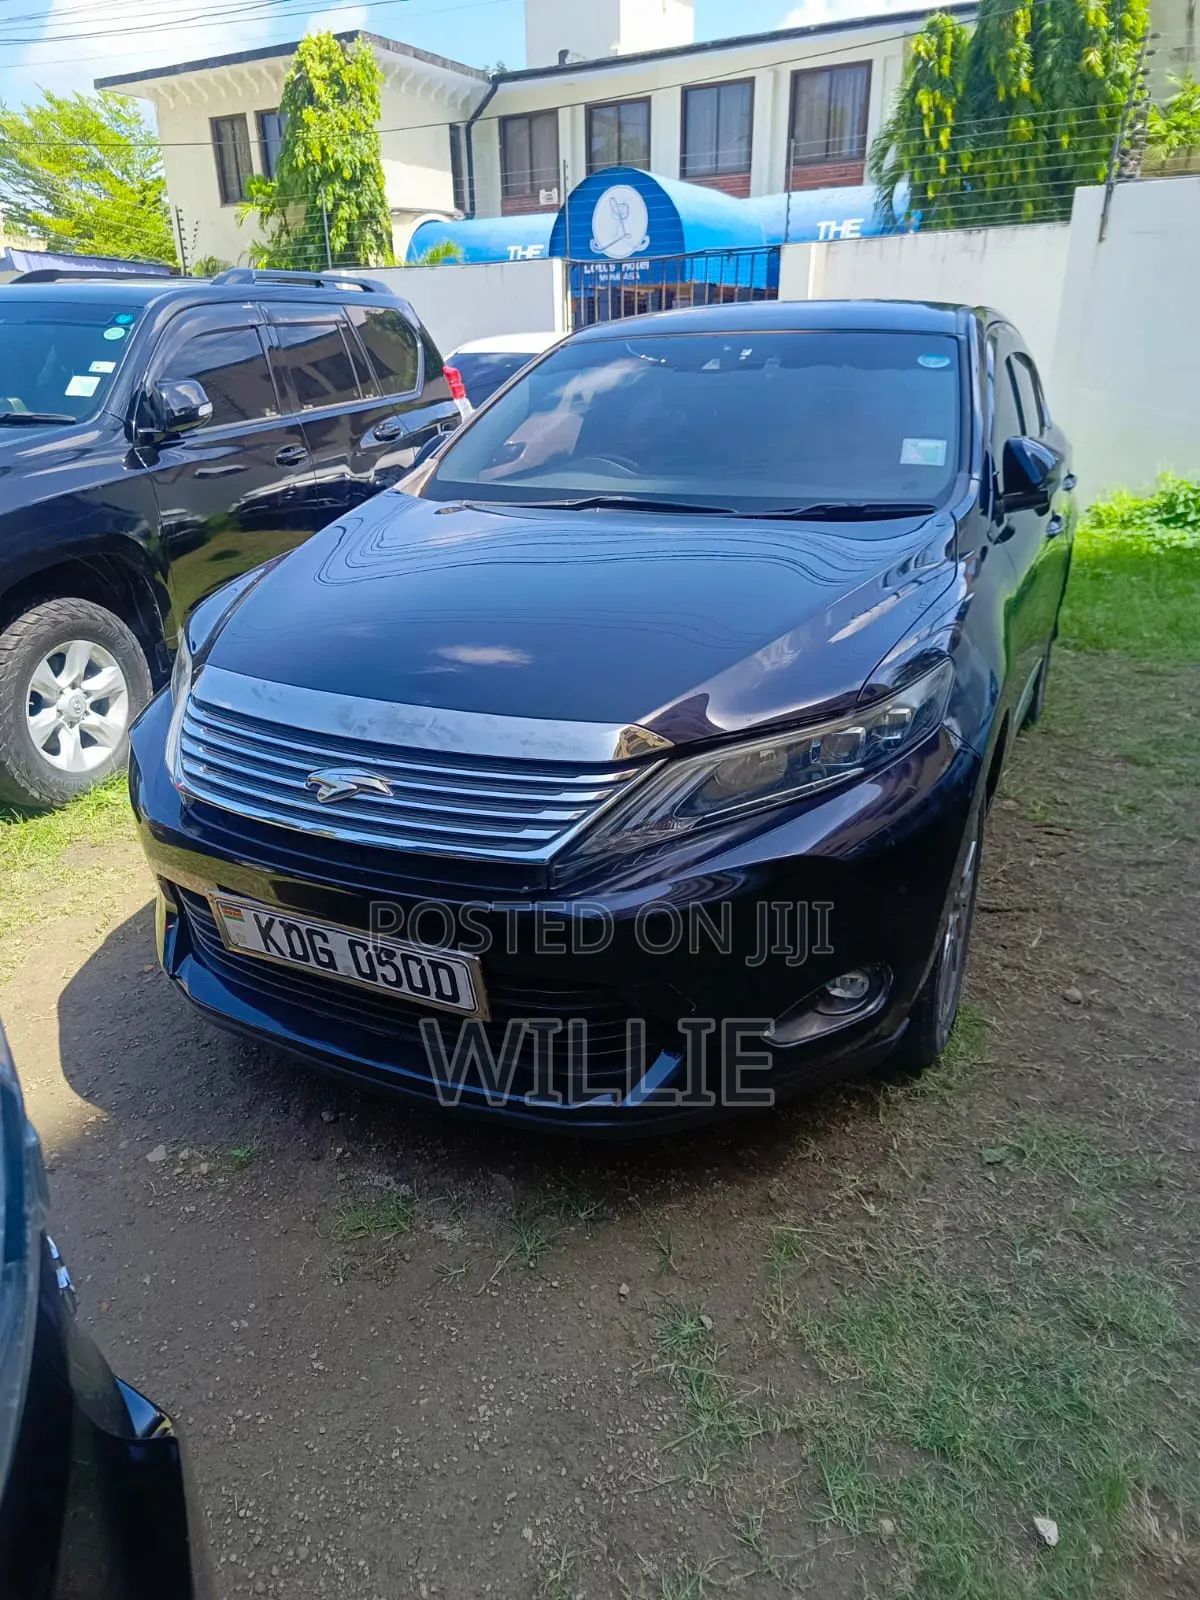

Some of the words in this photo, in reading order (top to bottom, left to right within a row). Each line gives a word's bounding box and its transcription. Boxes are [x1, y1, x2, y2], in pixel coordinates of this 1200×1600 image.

[816, 218, 865, 240] THE
[507, 244, 545, 261] THE
[252, 912, 339, 972] KDG
[347, 937, 461, 1004] 050D
